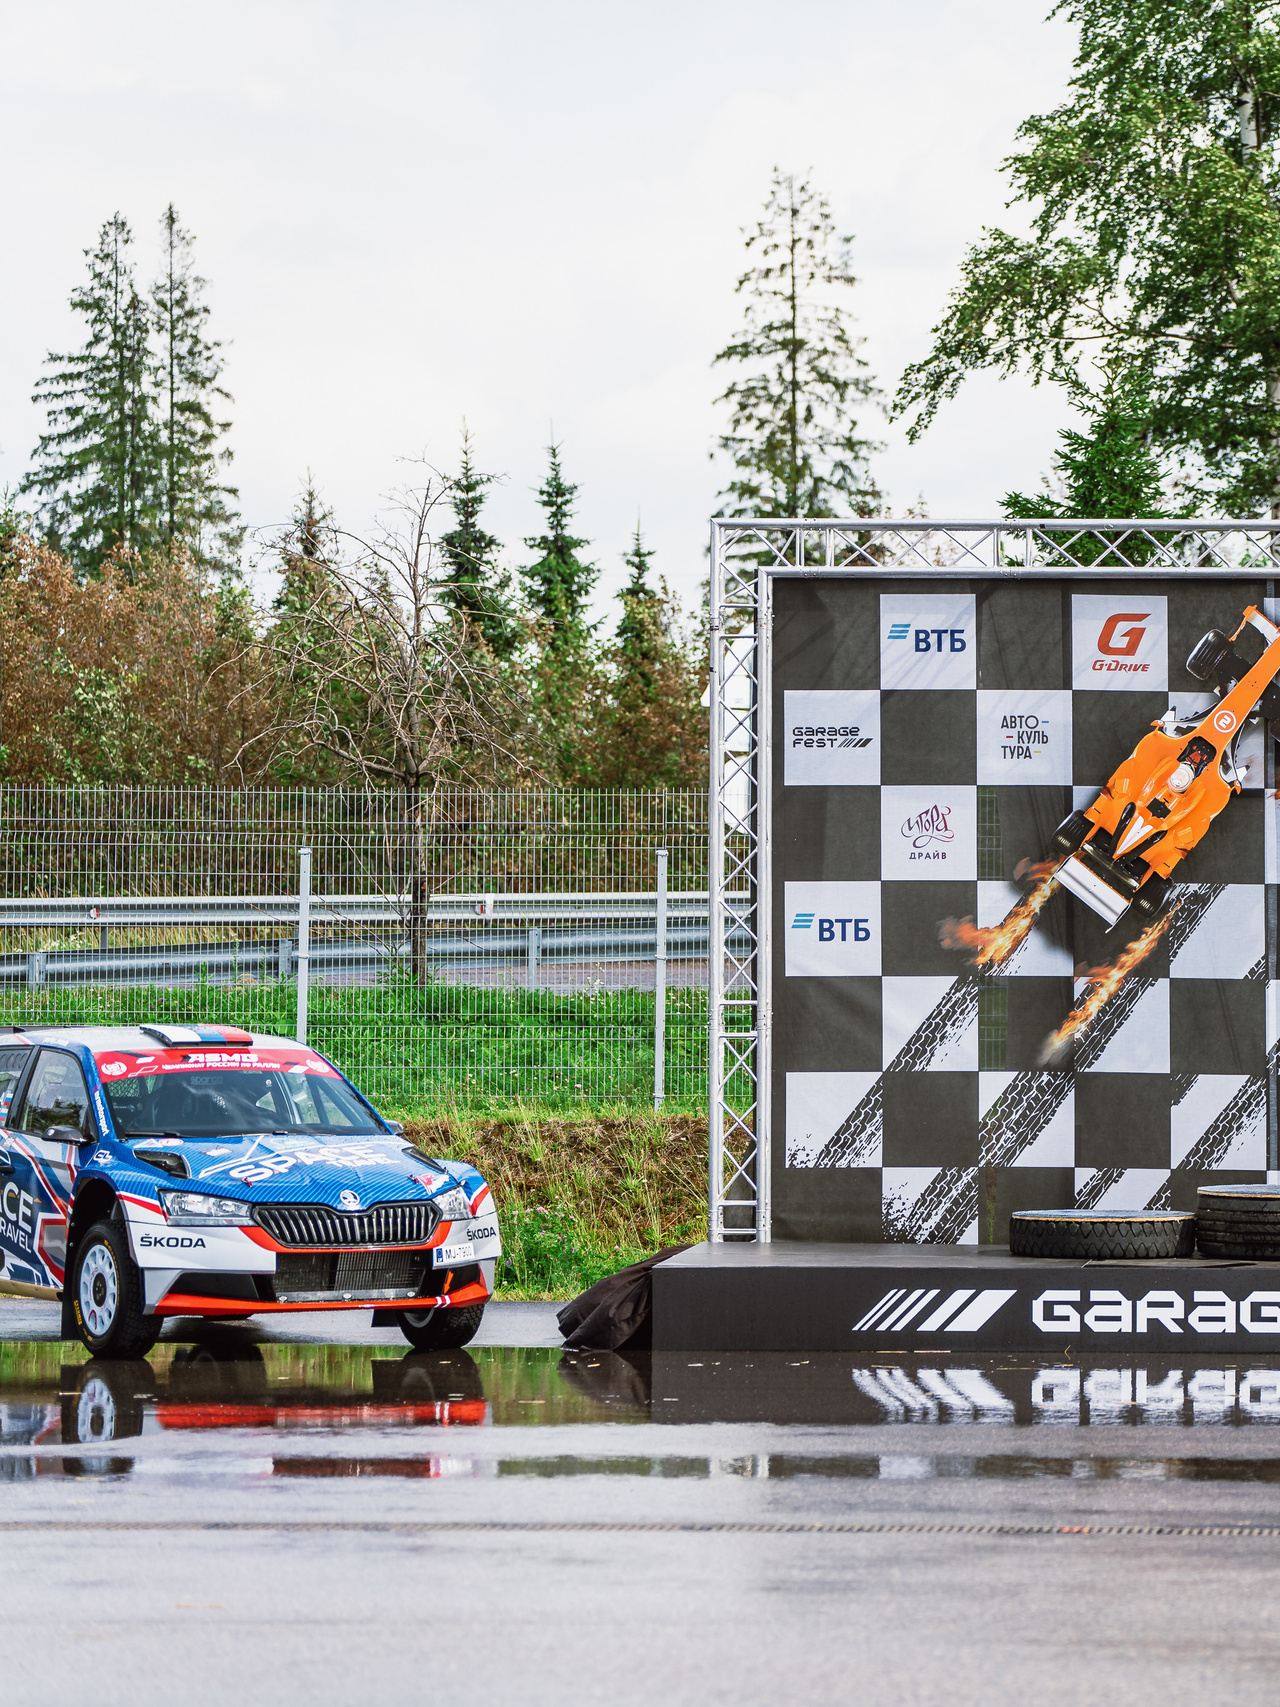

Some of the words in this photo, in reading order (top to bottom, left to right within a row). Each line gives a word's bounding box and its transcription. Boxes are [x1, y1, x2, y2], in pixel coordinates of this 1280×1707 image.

[914, 629, 967, 653] ВТБ
[1218, 714, 1232, 729] 2
[908, 850, 947, 860] ДРАЙВ
[818, 918, 871, 942] ВТБ
[229, 1145, 386, 1182] SPACE
[0, 1181, 34, 1234] CE
[139, 1233, 206, 1249] ŠKODA
[466, 1226, 497, 1241] ŠKODA
